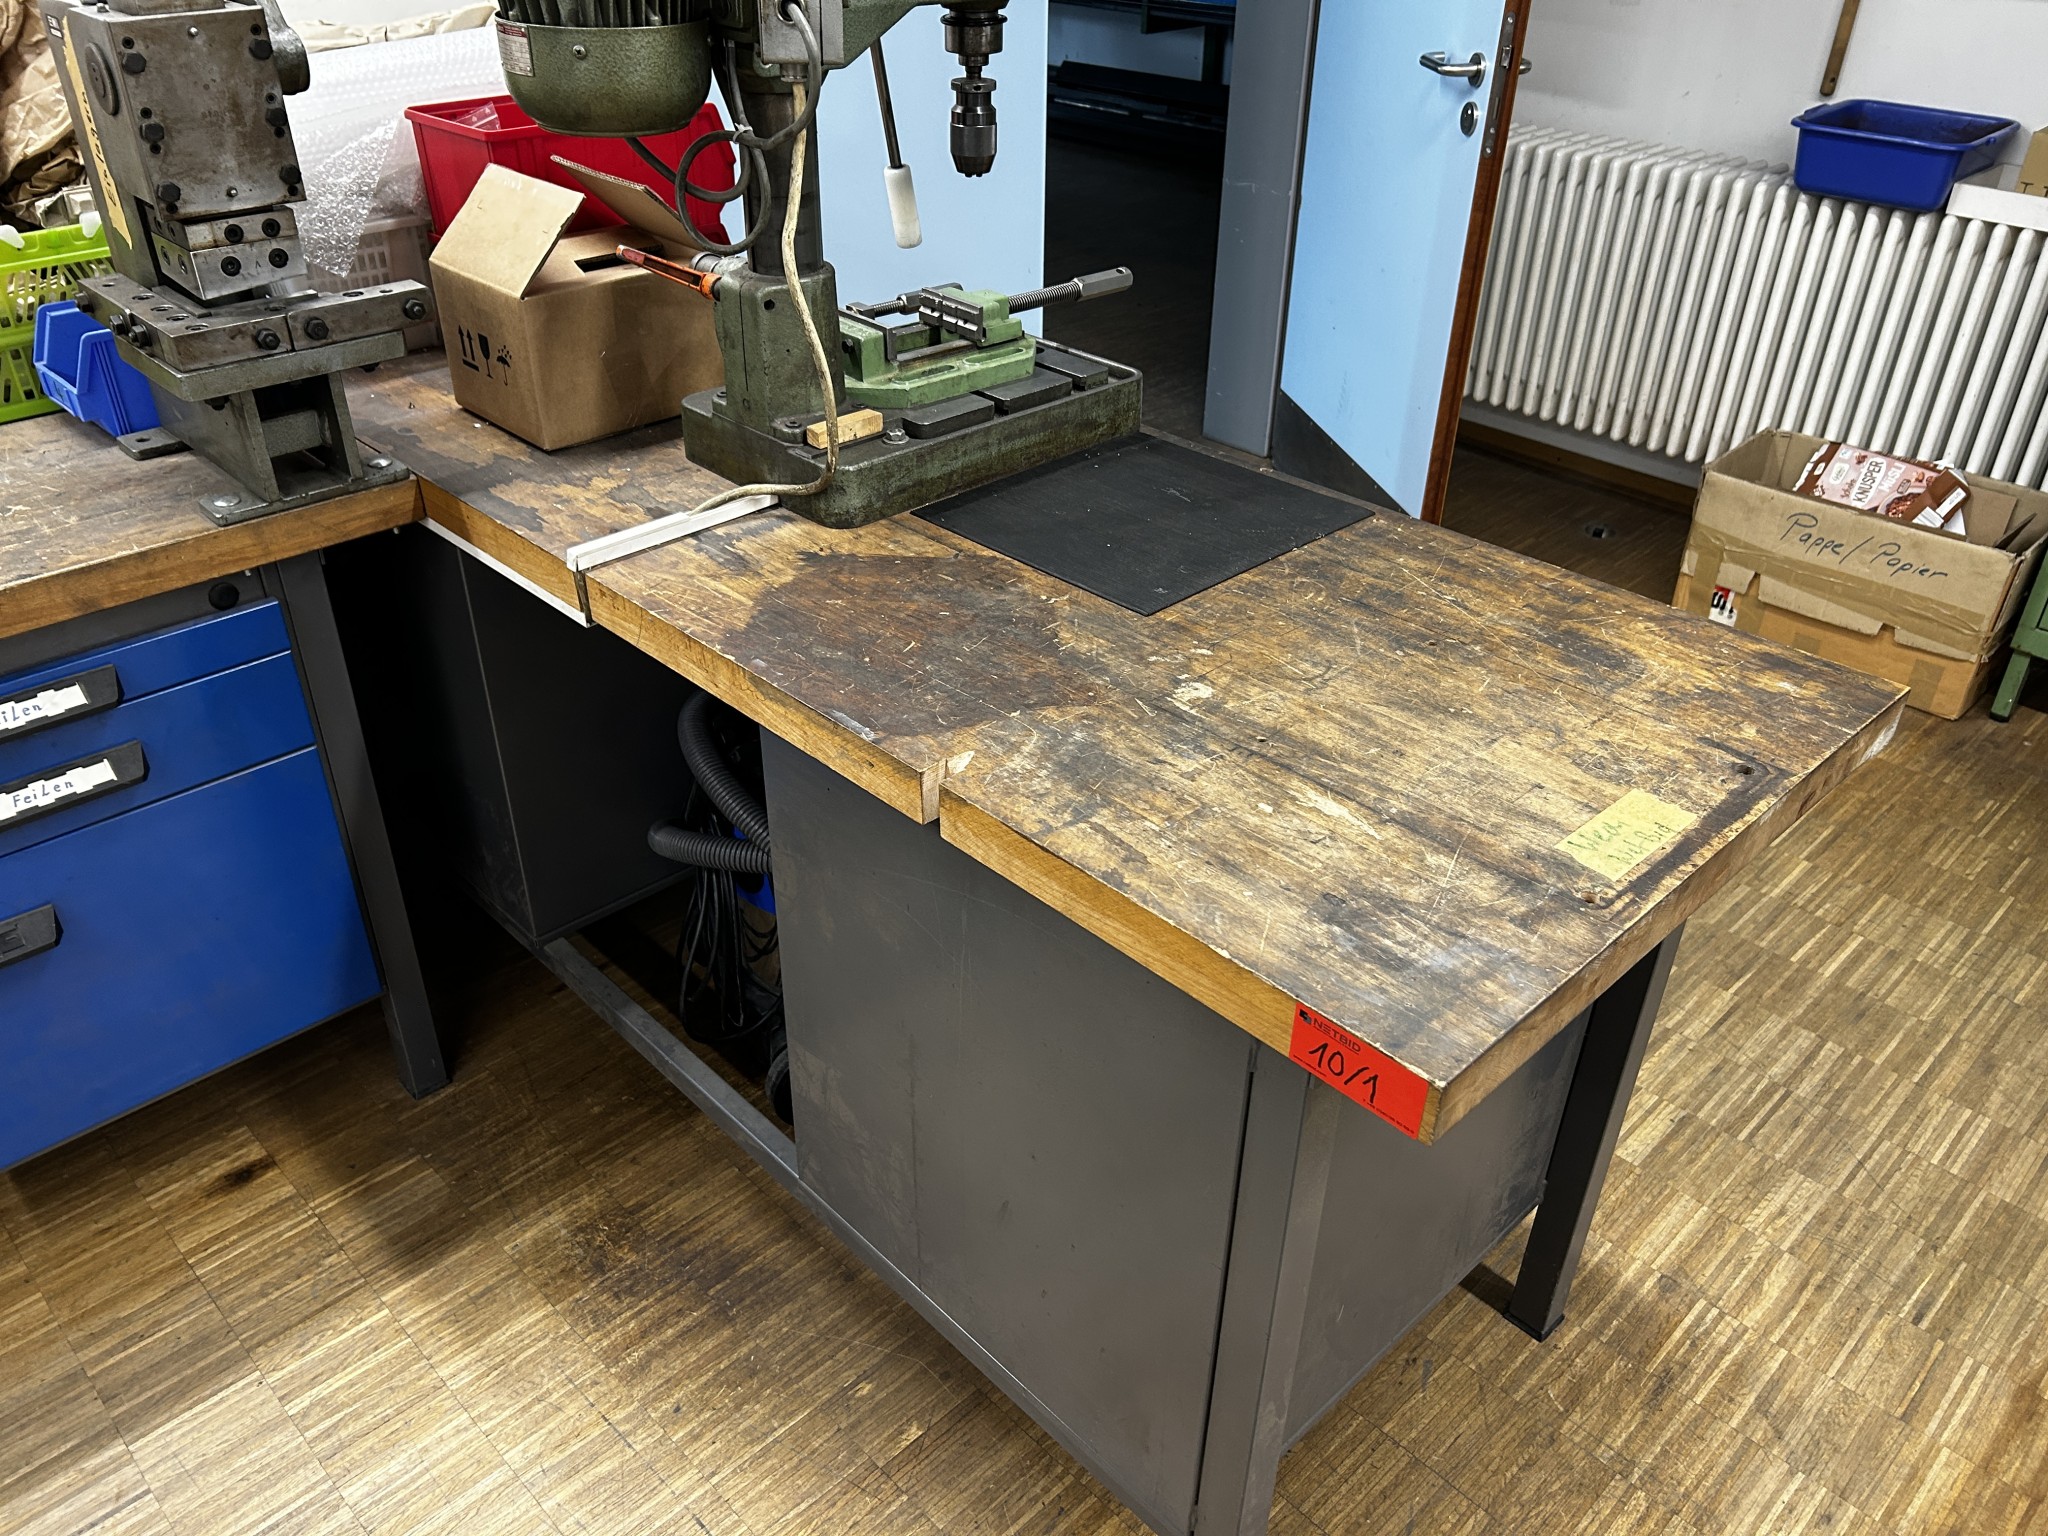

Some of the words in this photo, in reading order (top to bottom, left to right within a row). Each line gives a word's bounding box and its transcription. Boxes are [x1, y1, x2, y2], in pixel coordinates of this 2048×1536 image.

[1853, 460, 1884, 503] KNUSPER
[1878, 462, 1906, 493] MÜSLI
[1313, 1018, 1362, 1053] NETBID
[1308, 1042, 1379, 1104] 10/1
